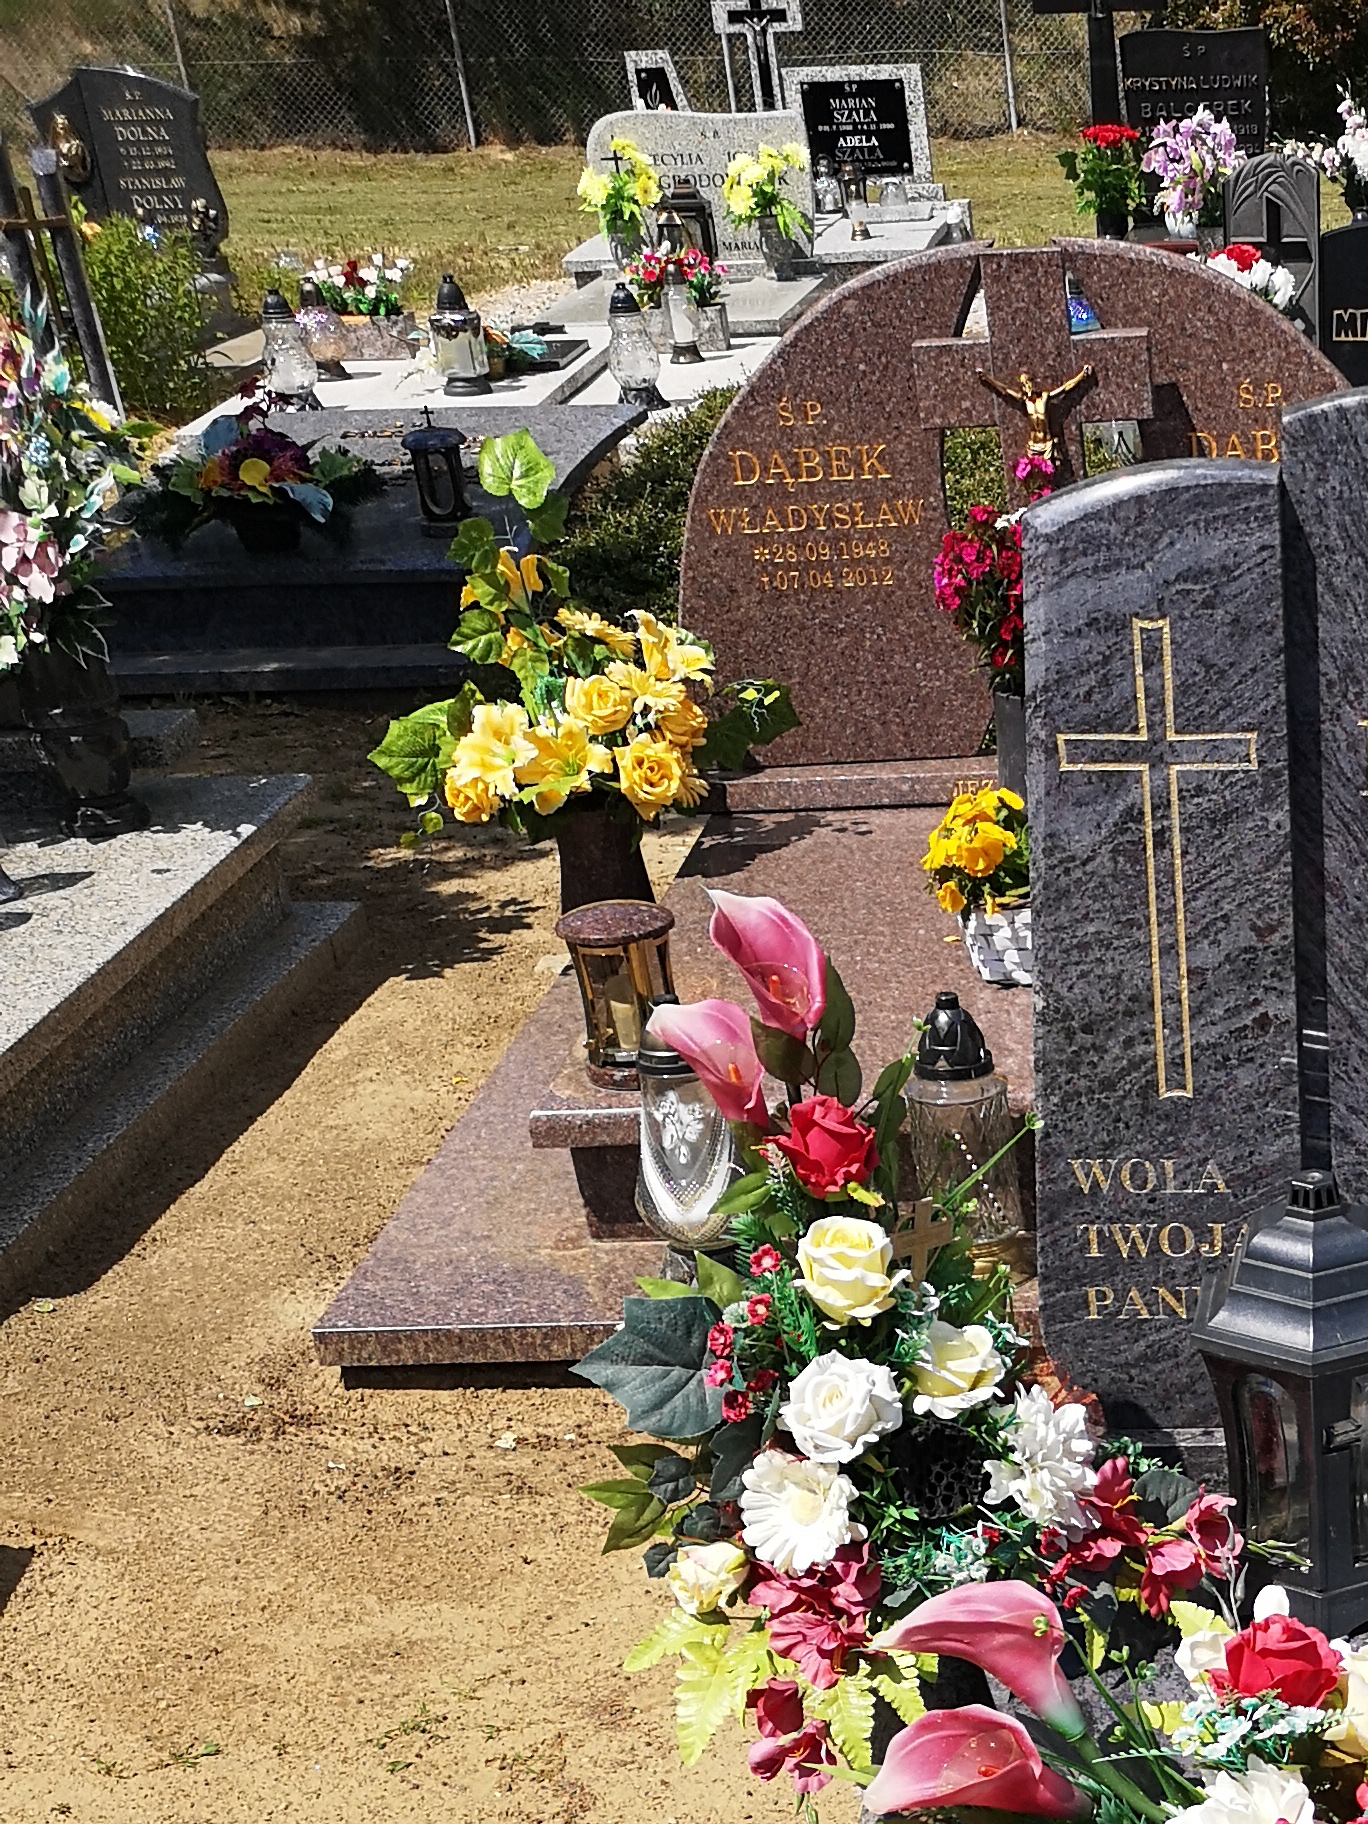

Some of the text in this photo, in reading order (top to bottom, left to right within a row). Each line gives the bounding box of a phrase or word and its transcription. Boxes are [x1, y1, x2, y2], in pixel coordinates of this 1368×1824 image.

[1124, 74, 1258, 91] KRYSTYNA LUDWIK
[829, 97, 876, 109] MARIAN
[100, 106, 174, 120] MARIANNA
[833, 109, 878, 123] SZALA
[113, 124, 171, 141] DOLNA
[838, 135, 879, 147] ADELA
[648, 152, 704, 167] ECYLIA
[835, 147, 884, 161] SZALA
[778, 397, 827, 426] Ś.P.
[728, 444, 892, 492] DĄBEK
[708, 499, 924, 536] WŁADYSŁAW
[1067, 1157, 1232, 1195] WOLA
